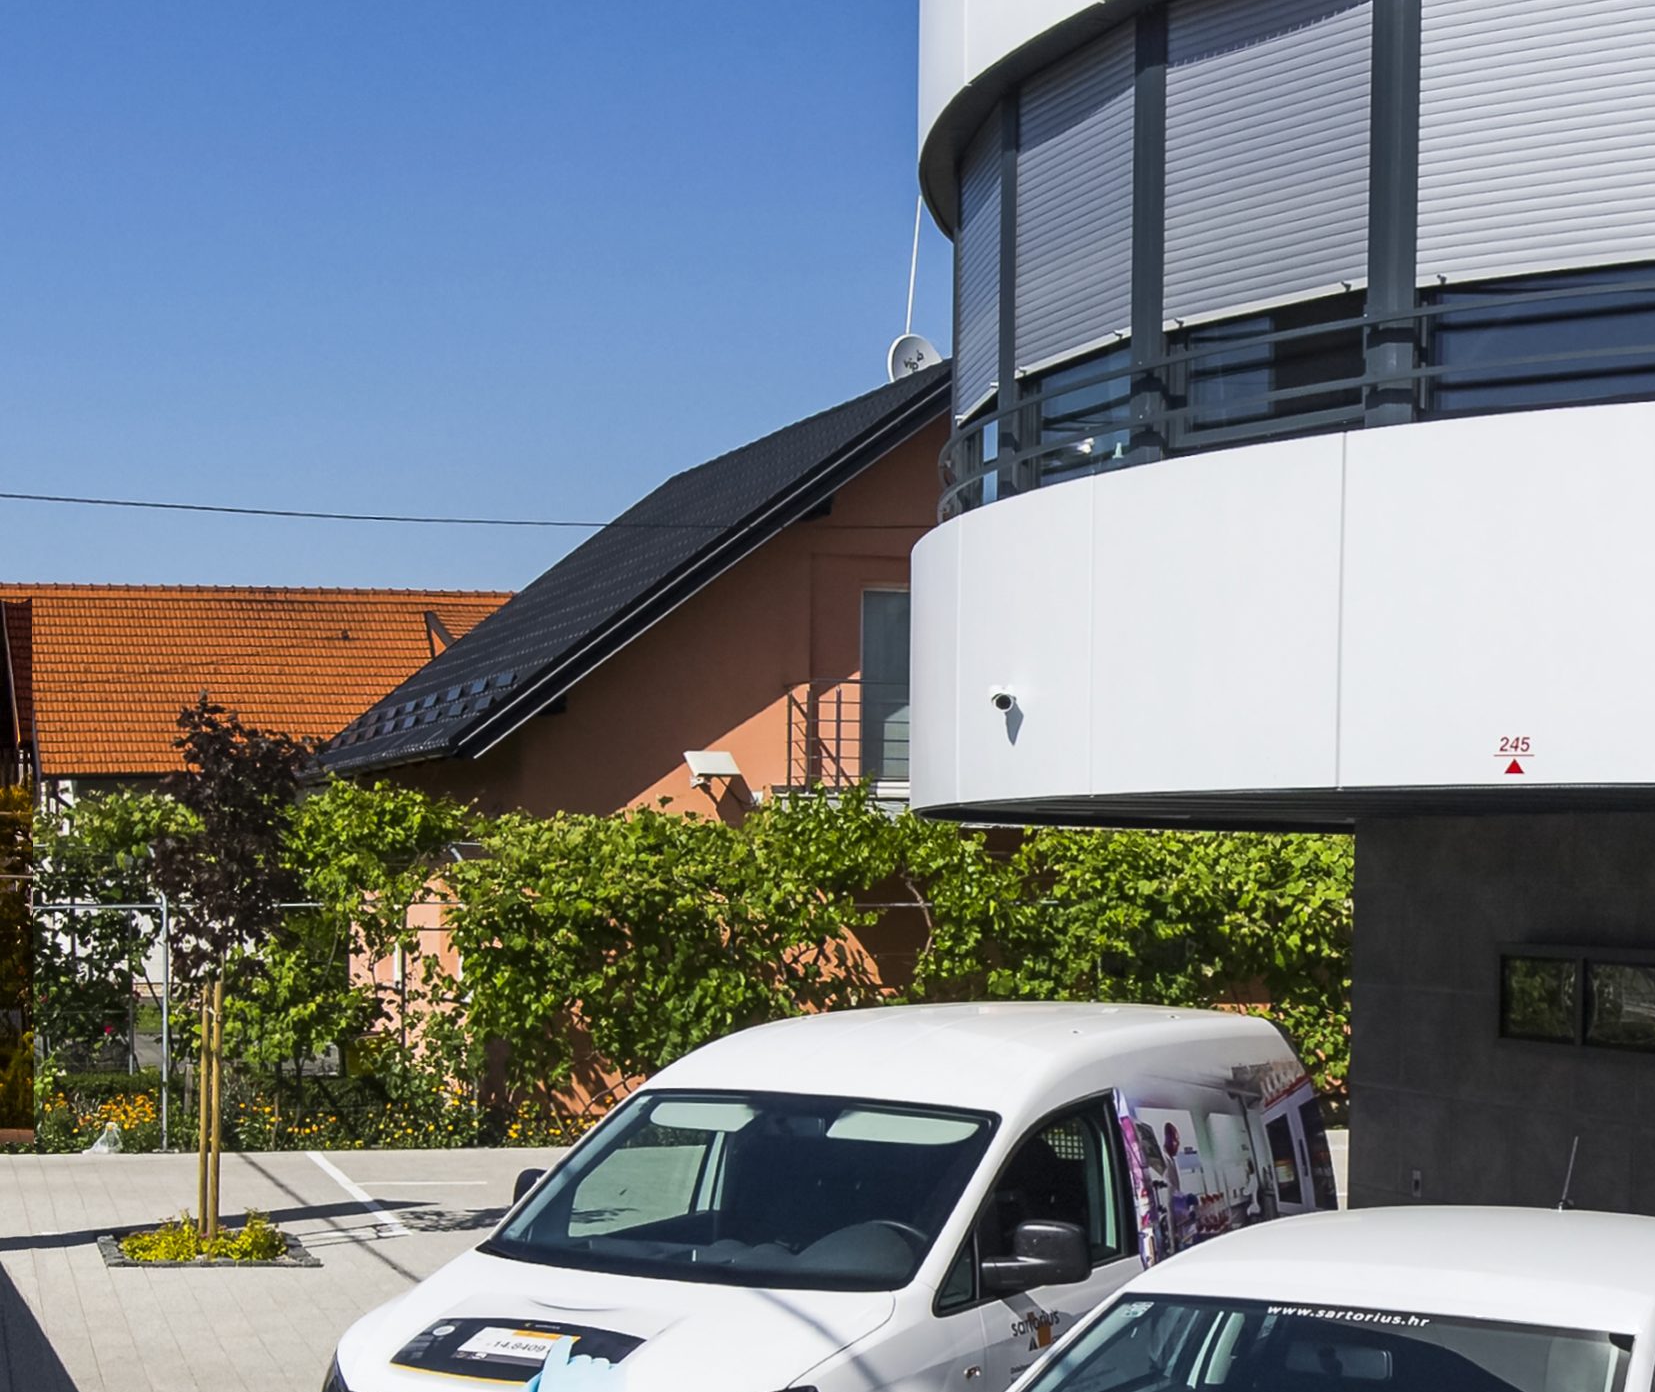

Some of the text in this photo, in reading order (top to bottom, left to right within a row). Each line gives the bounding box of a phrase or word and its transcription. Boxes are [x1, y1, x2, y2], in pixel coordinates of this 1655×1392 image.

[1499, 736, 1531, 752] 245
[1011, 1310, 1060, 1337] sartorius
[1267, 1306, 1431, 1328] www.sartorius.hr
